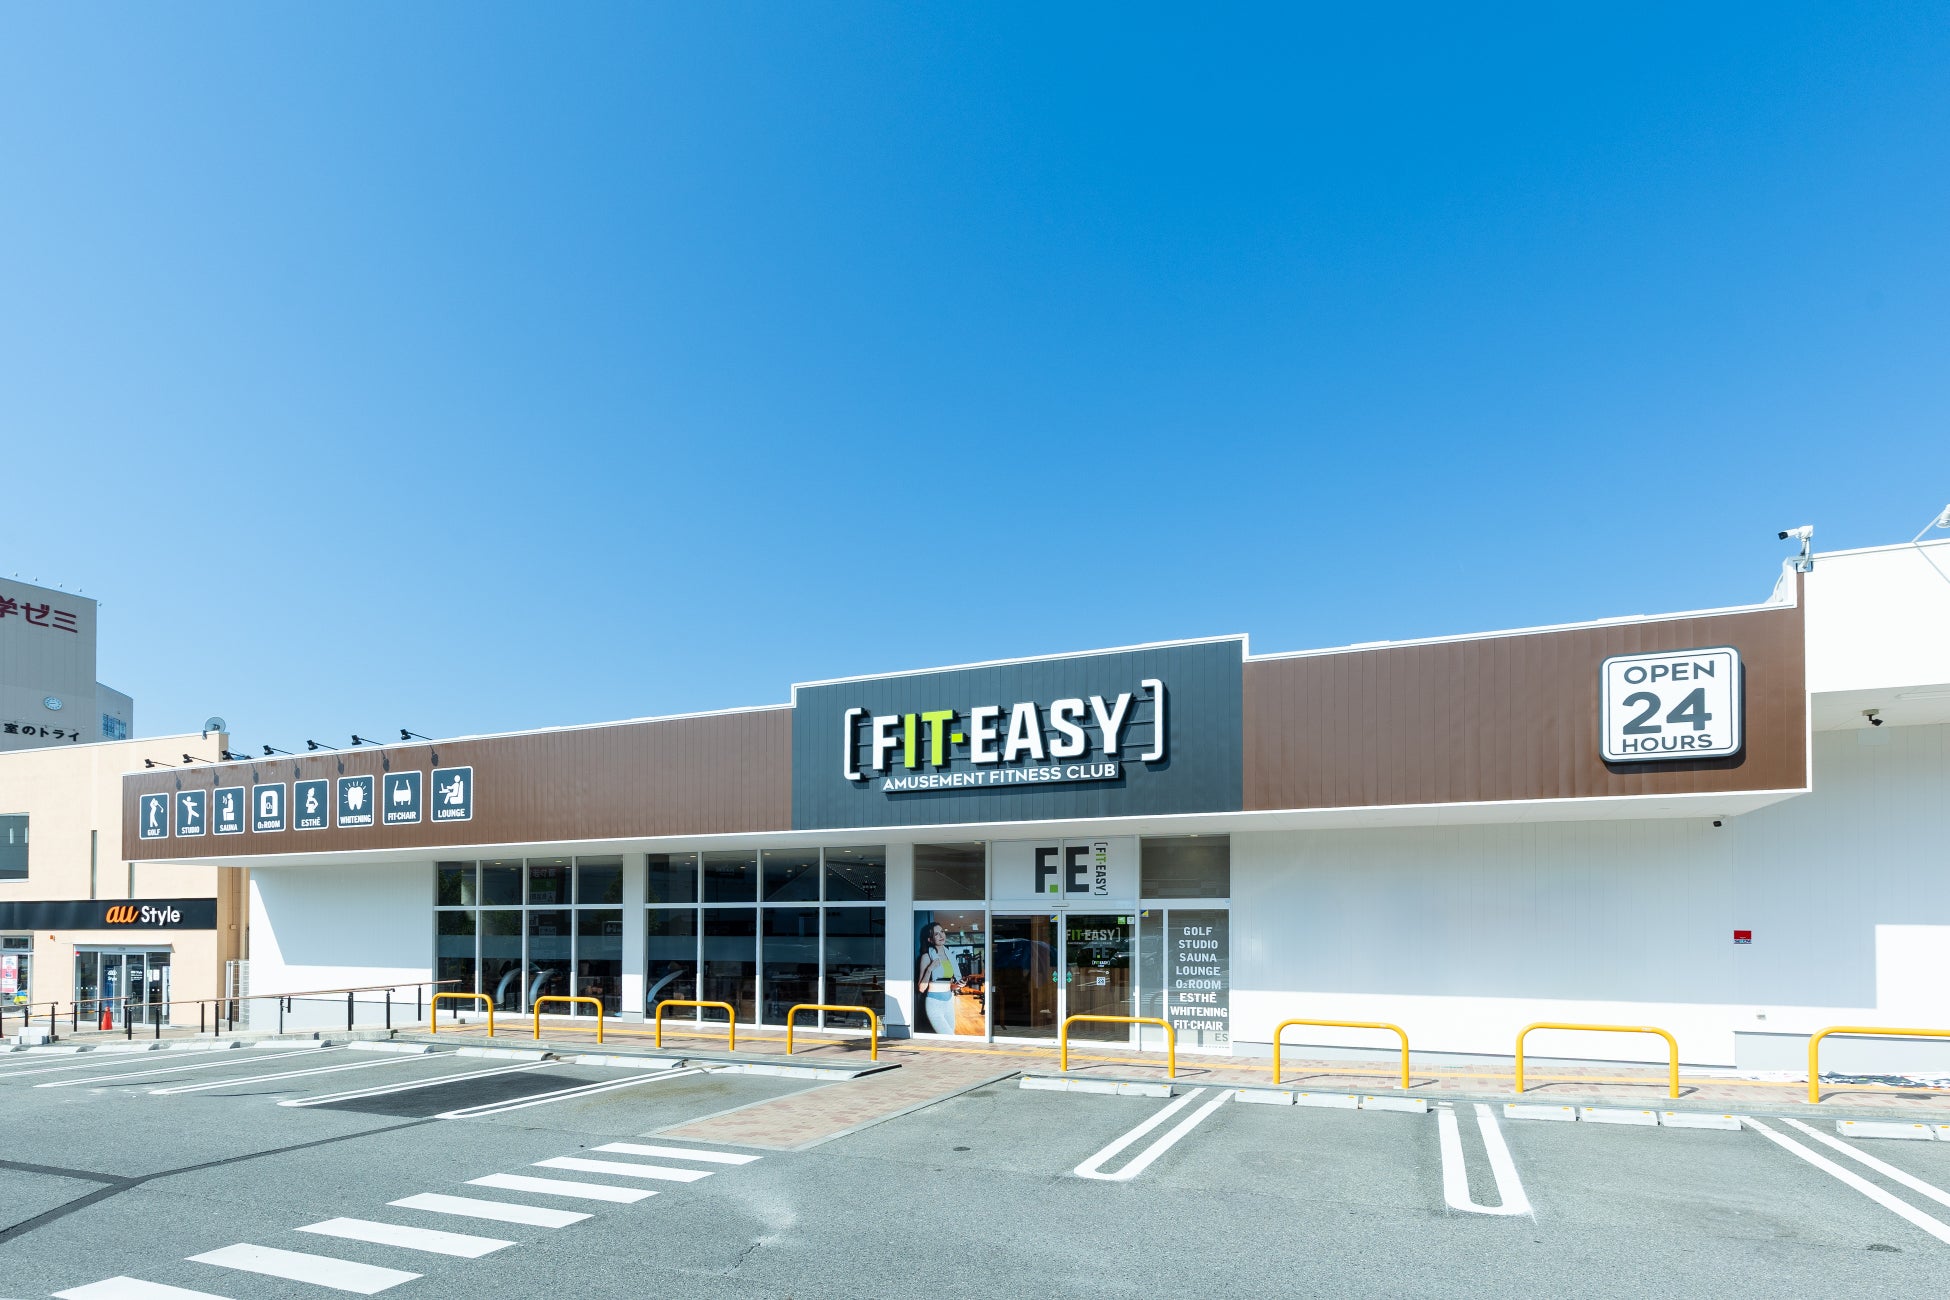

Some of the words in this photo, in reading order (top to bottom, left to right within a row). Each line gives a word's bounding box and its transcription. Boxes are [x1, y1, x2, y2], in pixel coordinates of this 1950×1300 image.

[1624, 660, 1715, 684] OPEN
[1622, 688, 1713, 735] 24
[3, 723, 81, 742] 室のトライ
[1623, 734, 1713, 753] HOURS
[883, 771, 985, 791] AMUSEMENT
[989, 766, 1061, 784] FITNESS
[1066, 763, 1116, 778] CLUB
[438, 808, 465, 818] LOUNGE
[340, 814, 371, 824] WHITENING
[181, 826, 200, 834] STUDIO
[219, 824, 238, 832] SAUNA
[105, 905, 139, 924] au
[141, 905, 181, 926] Style
[1184, 926, 1213, 936] GOLF
[1178, 940, 1218, 949] STUDIO
[1179, 953, 1217, 963] SAUNA
[1176, 966, 1221, 976] LOUNGE
[1170, 1006, 1228, 1018] WHITENING
